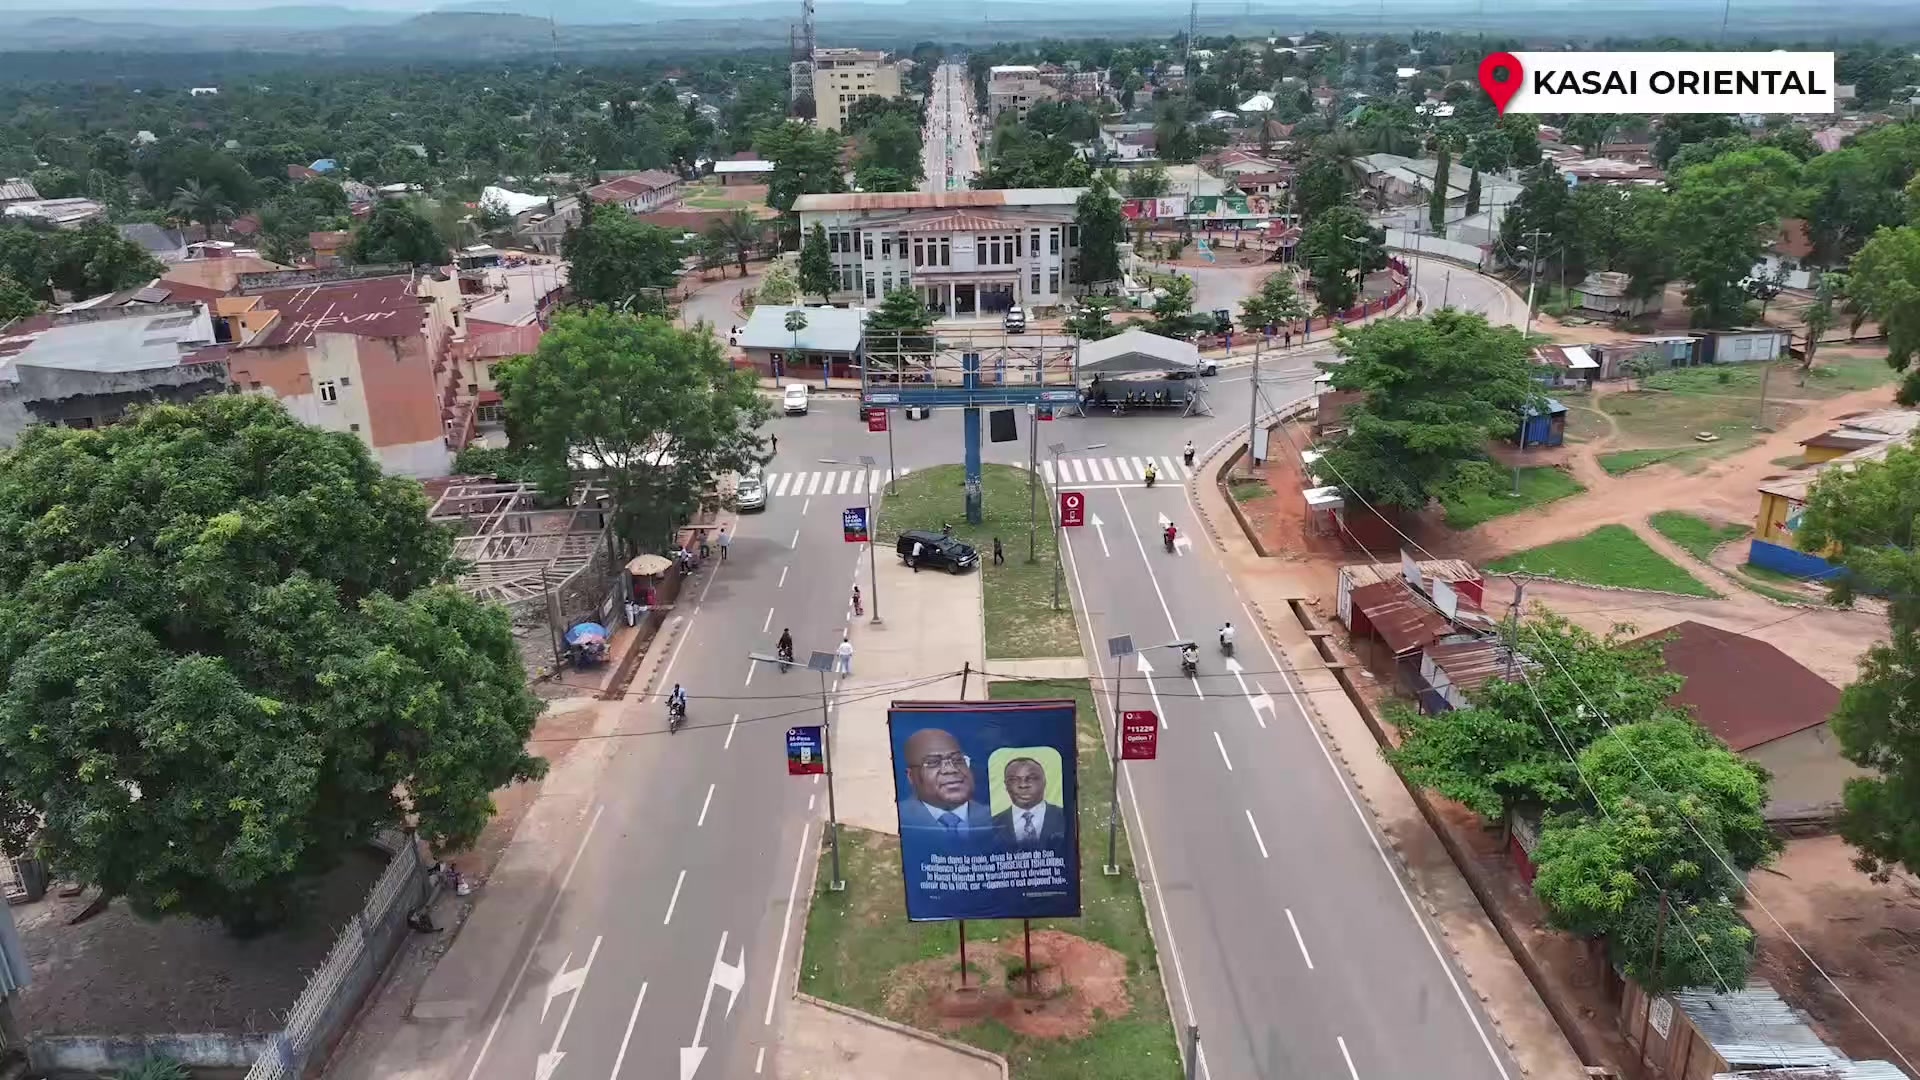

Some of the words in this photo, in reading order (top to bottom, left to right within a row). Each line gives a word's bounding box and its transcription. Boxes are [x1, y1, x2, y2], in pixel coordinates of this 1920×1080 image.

[930, 854, 947, 864] Main
[947, 856, 964, 865] dans
[964, 855, 970, 864] la
[971, 855, 989, 865] main,
[989, 853, 1006, 863] dans
[1006, 852, 1013, 861] la
[1013, 850, 1033, 860] vision
[1033, 850, 1042, 859] de
[1042, 849, 1055, 858] Son
[920, 862, 954, 873] Excellence
[951, 872, 976, 882] Oriental
[985, 870, 1020, 881] transforme
[1020, 869, 1028, 878] et
[1028, 867, 1052, 877] devient
[939, 881, 948, 890] de
[948, 881, 955, 890] la
[970, 882, 981, 891] car
